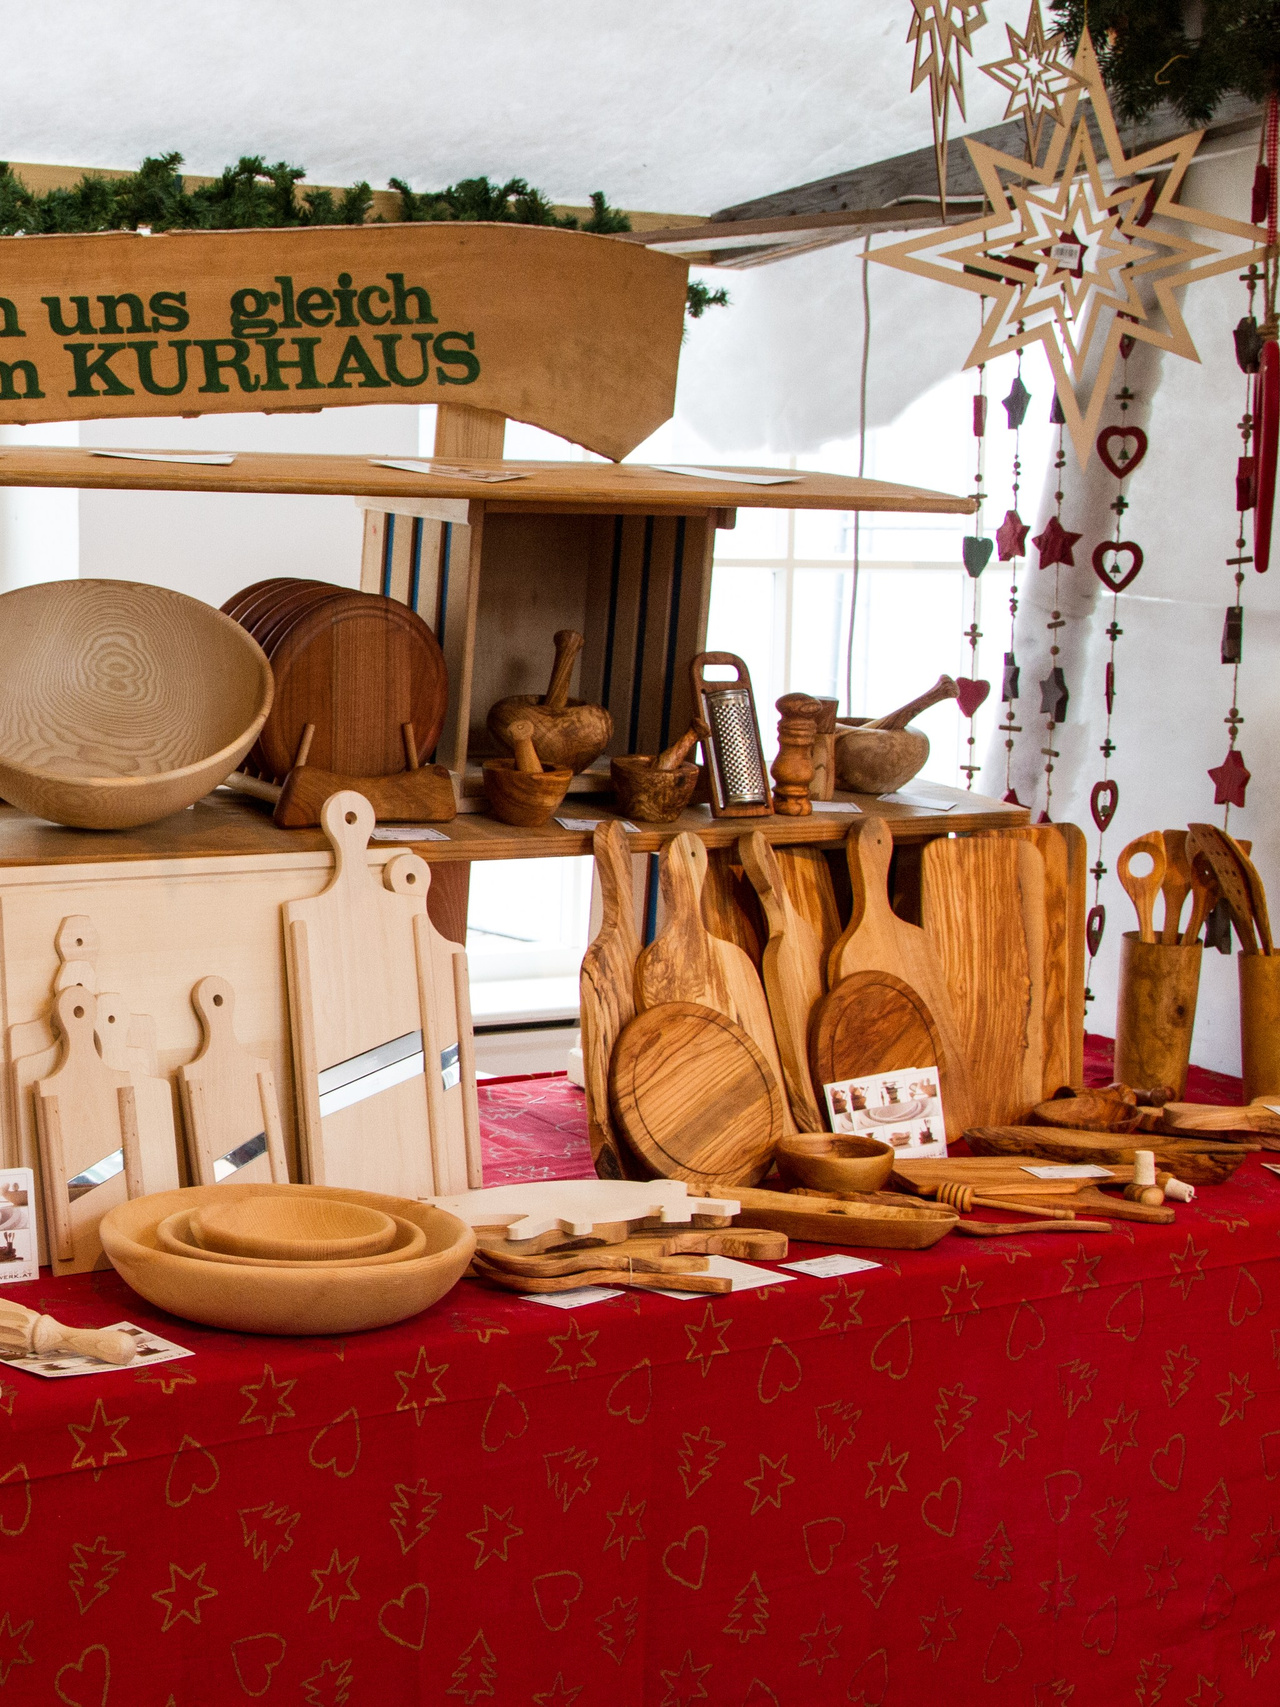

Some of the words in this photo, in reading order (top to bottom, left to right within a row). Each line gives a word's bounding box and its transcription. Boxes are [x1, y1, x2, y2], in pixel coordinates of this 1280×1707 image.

[47, 290, 190, 336] uns
[229, 272, 439, 339] gleich
[67, 332, 482, 398] KURHAUS
